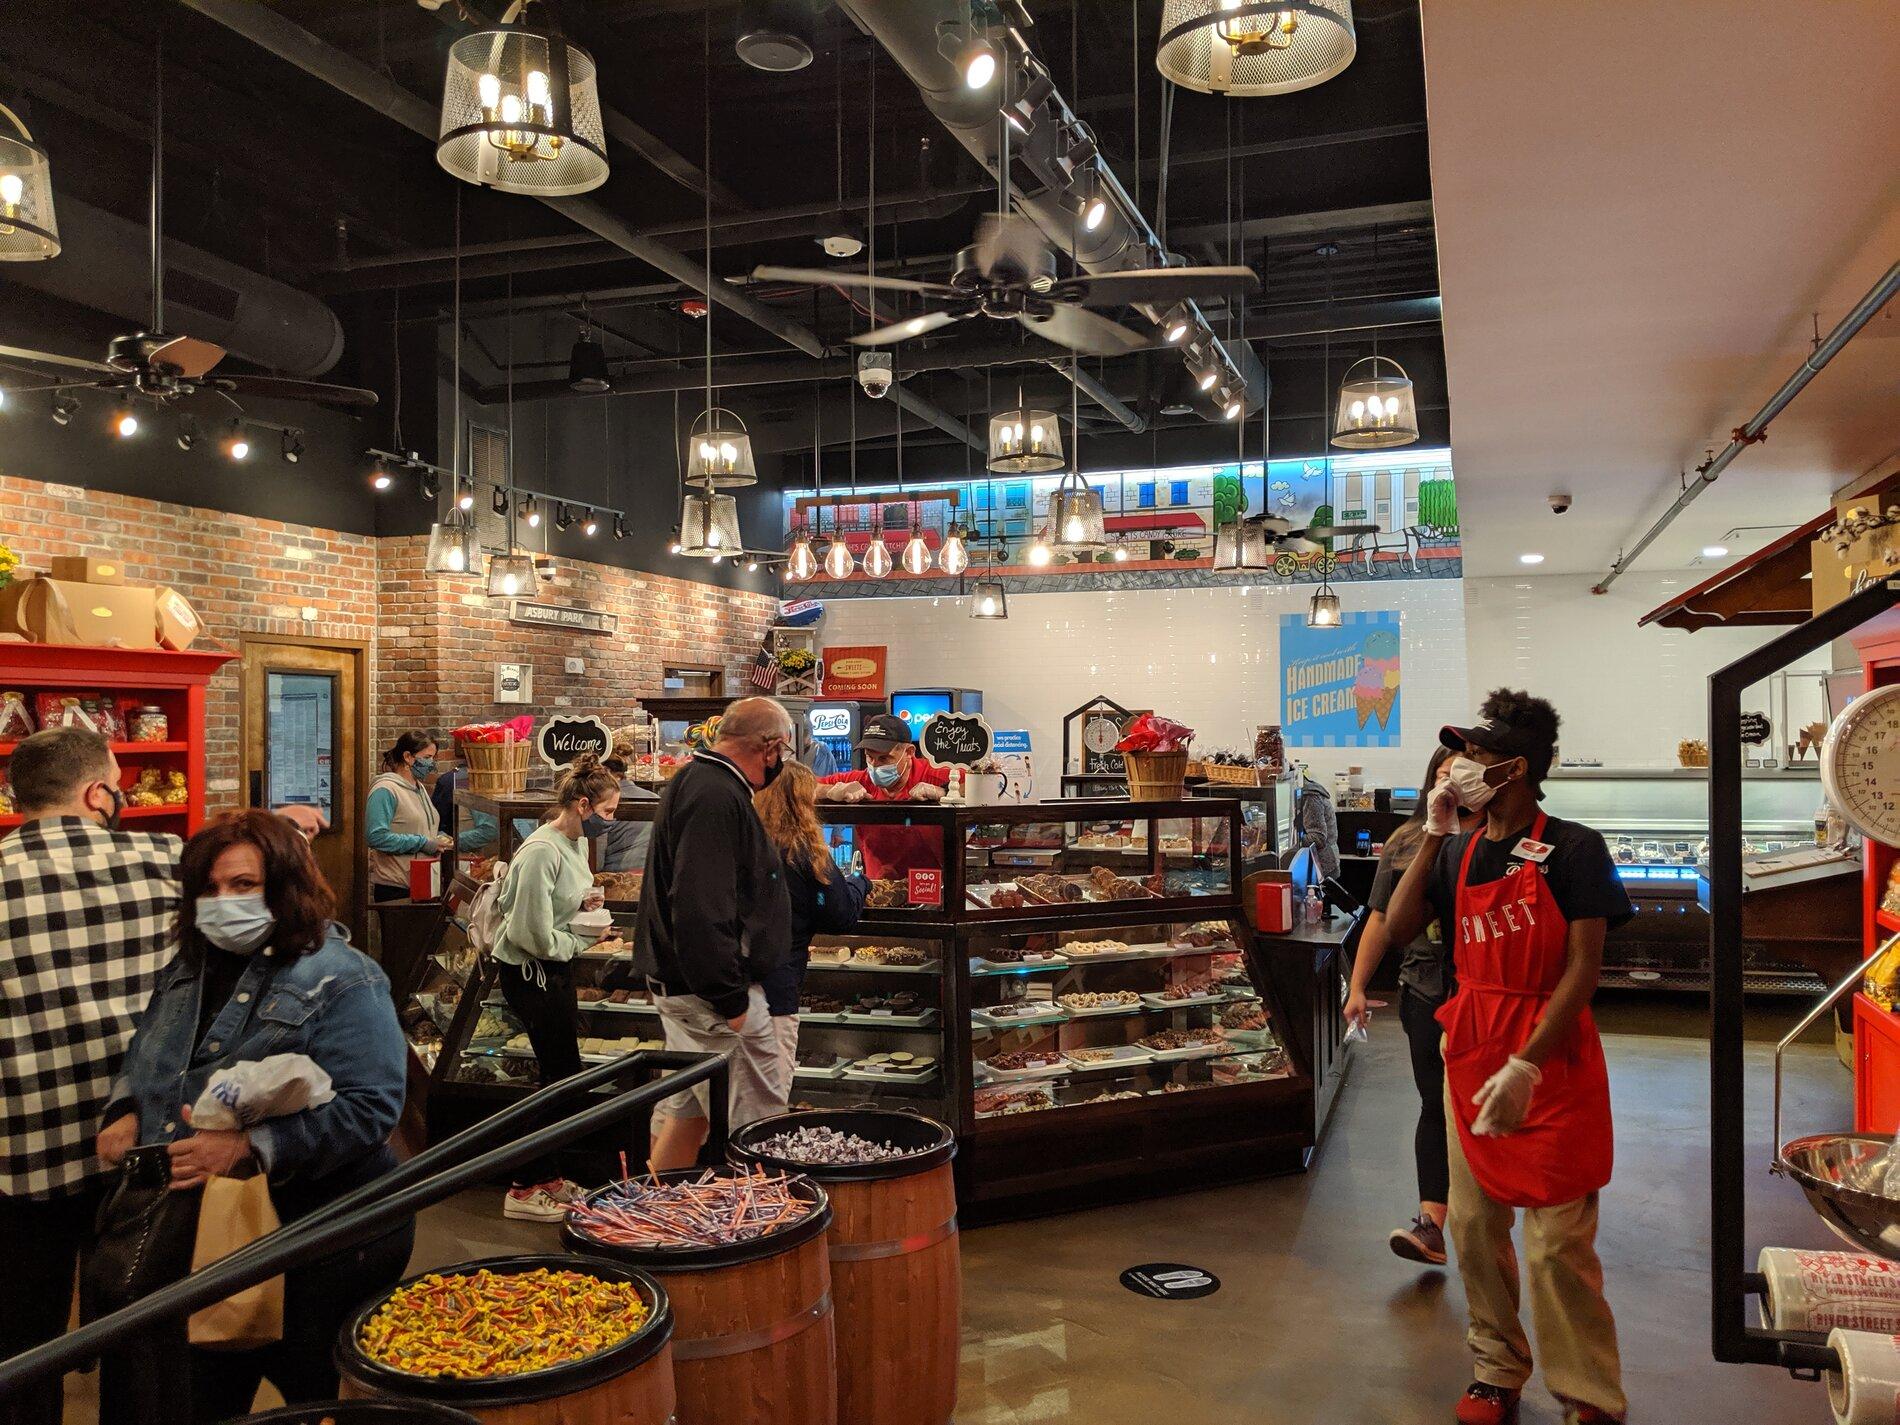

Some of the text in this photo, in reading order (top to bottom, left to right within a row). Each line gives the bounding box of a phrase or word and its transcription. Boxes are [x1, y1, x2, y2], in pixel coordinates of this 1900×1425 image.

[1140, 530, 1160, 540] CANDY
[524, 607, 584, 623] ASBURY PARK
[1286, 653, 1362, 696] HANDMADE
[1287, 685, 1357, 726] ICE CREAM
[935, 721, 969, 740] Enjoy
[1887, 720, 1899, 729] 18
[552, 732, 603, 751] Welcome
[1874, 731, 1887, 740] 17
[934, 737, 951, 750] the
[1866, 746, 1878, 755] 16
[1861, 761, 1874, 770] 15
[1864, 777, 1877, 786] 14
[1871, 791, 1883, 800] 13
[1882, 801, 1895, 811] 12
[1461, 898, 1536, 944] SWEET
[1846, 1273, 1886, 1288] STREET
[1816, 1313, 1849, 1327] RIVER
[1852, 1315, 1894, 1329] STREET
